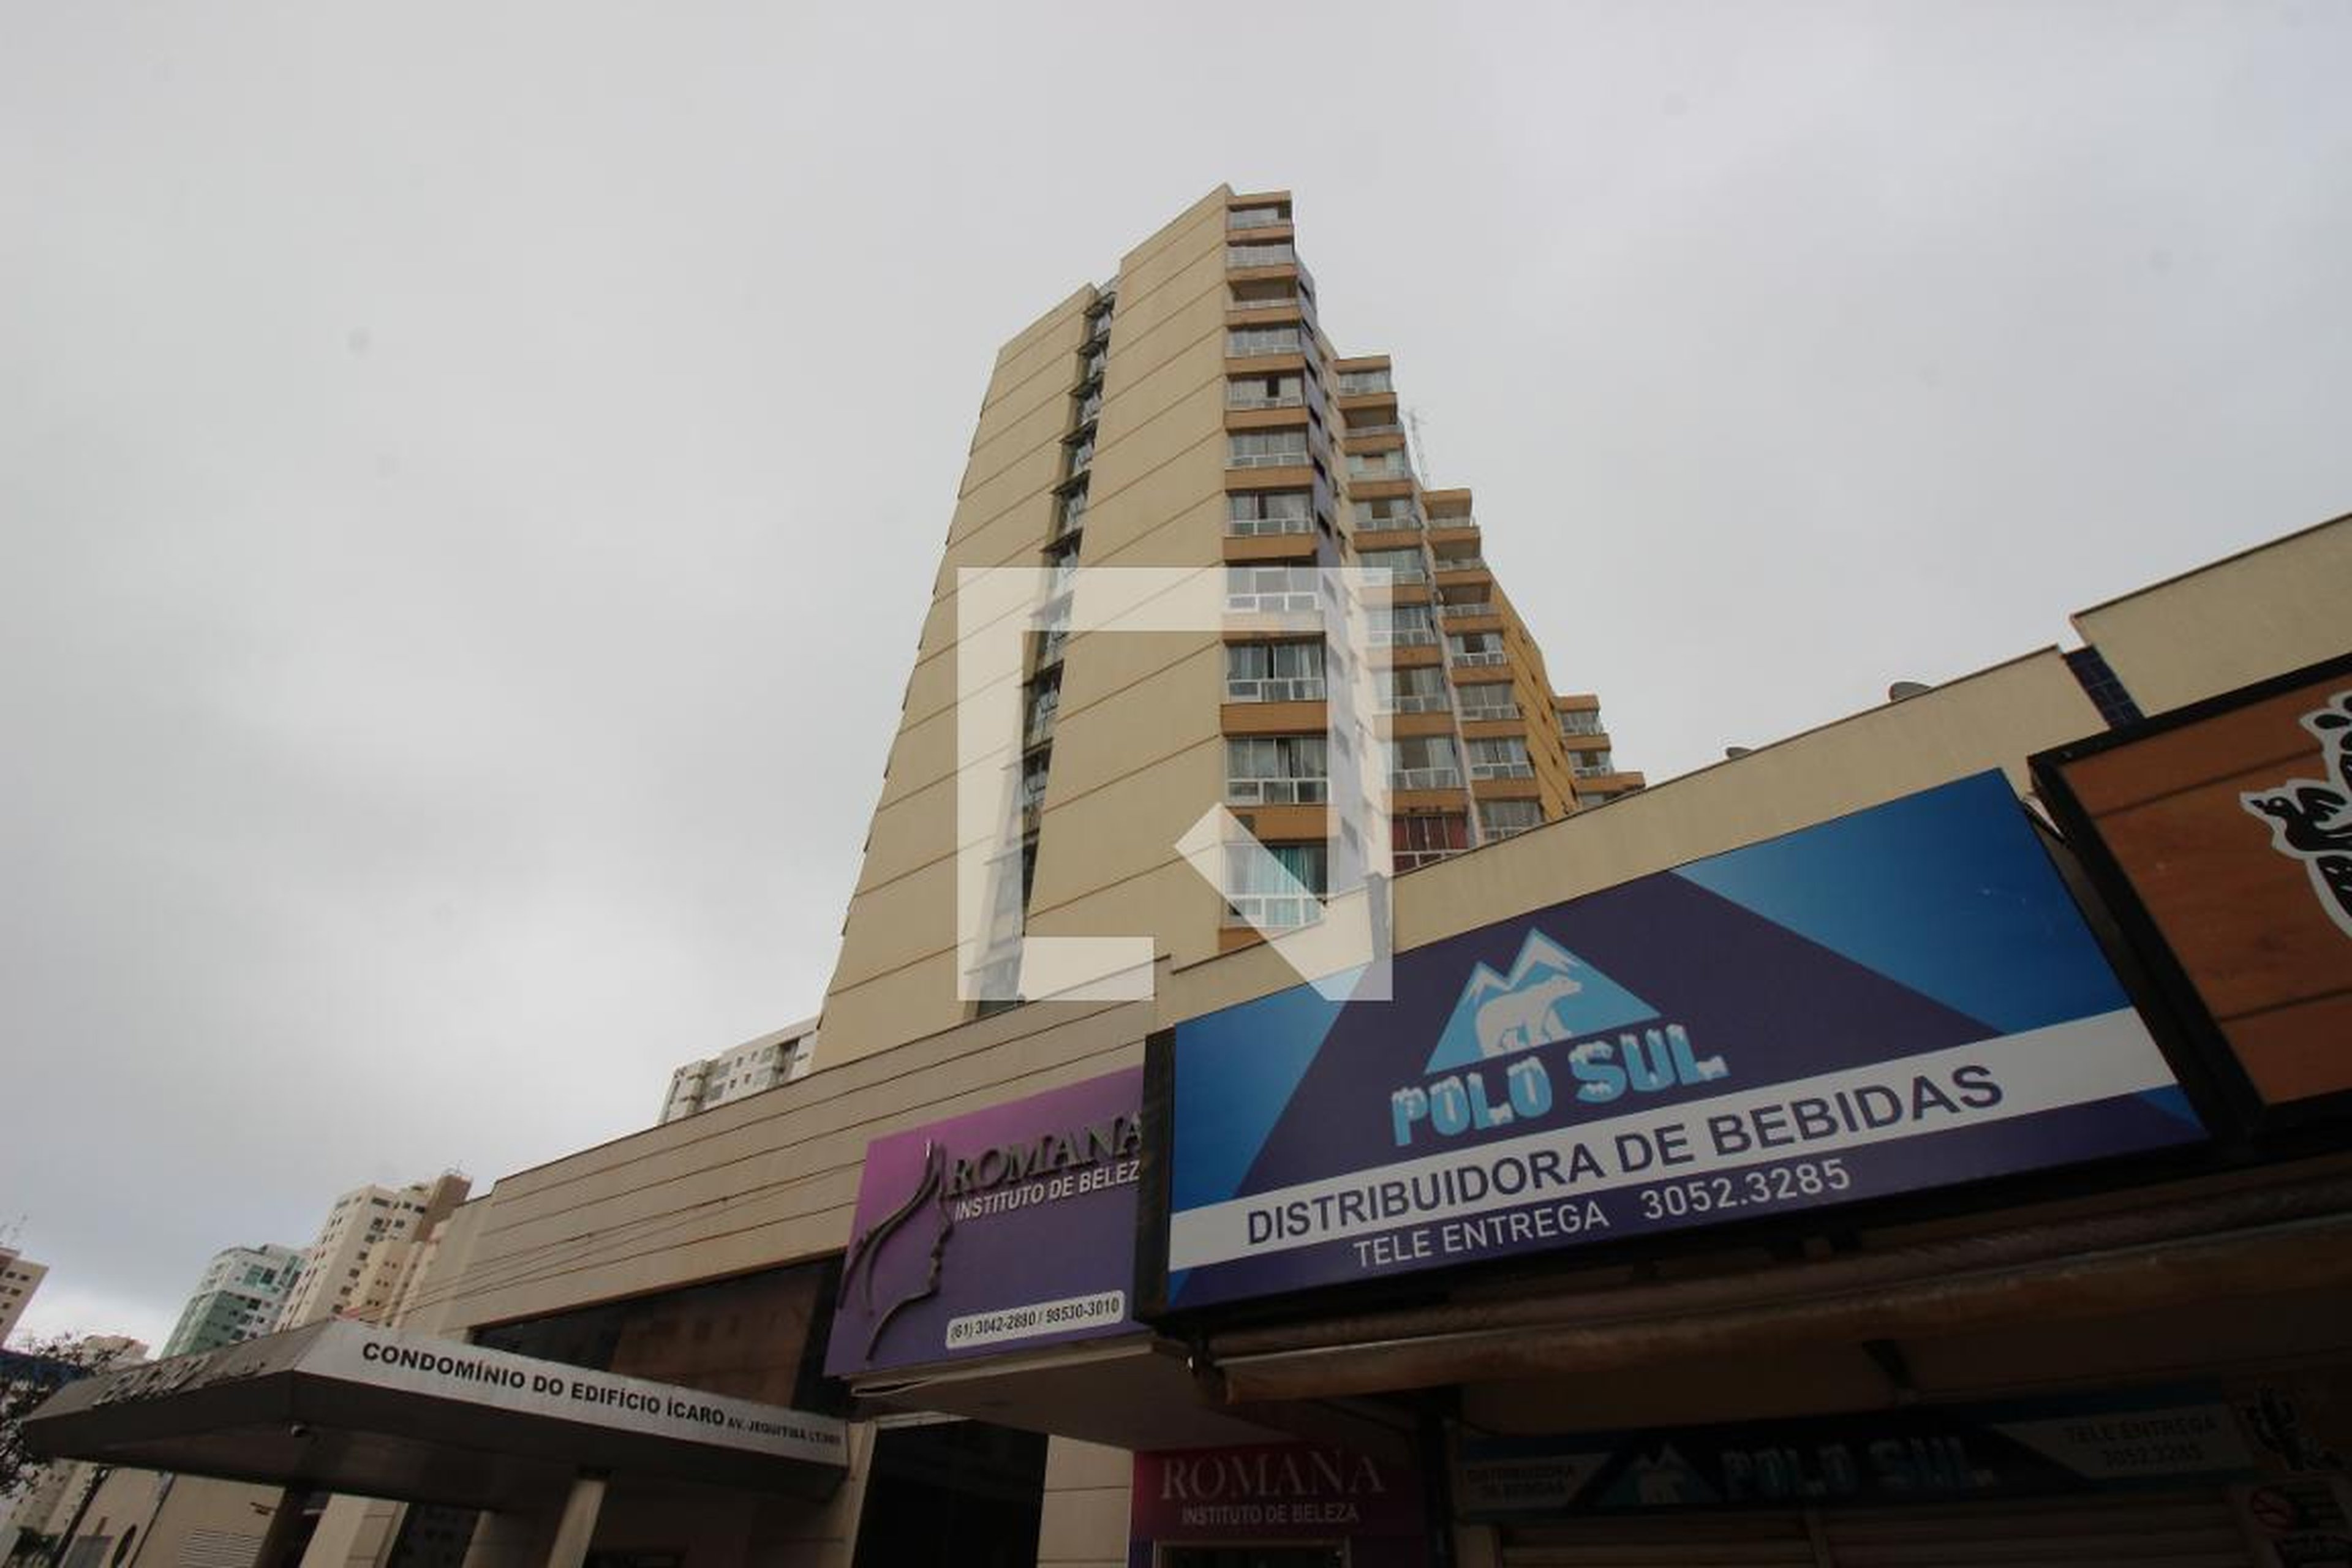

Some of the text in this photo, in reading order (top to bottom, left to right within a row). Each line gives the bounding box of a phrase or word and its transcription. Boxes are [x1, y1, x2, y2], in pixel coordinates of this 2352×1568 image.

[1390, 1023, 1730, 1147] POLO SUL
[946, 1112, 1142, 1197] ROMANA
[955, 1160, 1140, 1221] INSTITUTO DE BELEZ
[1247, 1065, 2003, 1245] DISTRIBUIDORA DE BEBIDAS
[1354, 1159, 1852, 1268] TELE ENTREGA 3052.3285
[363, 1342, 525, 1389] CONDOMÍNIO
[533, 1374, 564, 1396] DO
[571, 1382, 660, 1414] EDIFÍCIO
[667, 1396, 724, 1427] ÍCARO
[1161, 1450, 1387, 1500] ROMANA
[1182, 1502, 1359, 1525] INSTITUTO DE BELEZA
